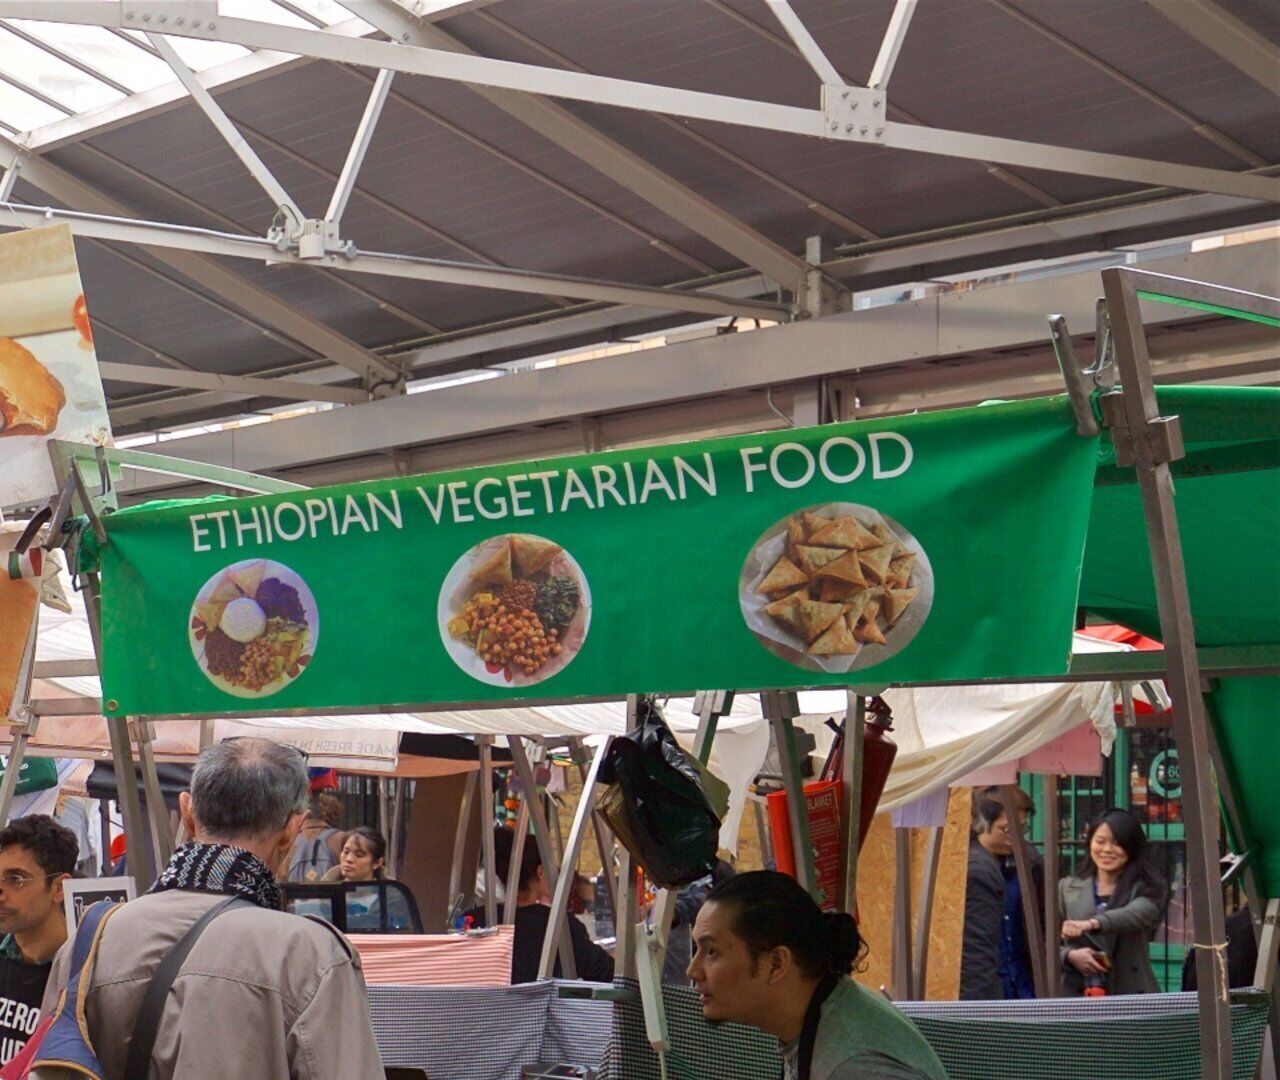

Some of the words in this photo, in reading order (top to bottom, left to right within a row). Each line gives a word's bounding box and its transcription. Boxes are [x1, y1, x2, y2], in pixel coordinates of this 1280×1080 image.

[190, 488, 404, 552] ETHIOPIAN
[416, 452, 718, 525] VEGETARIAN
[739, 431, 915, 493] FOOD
